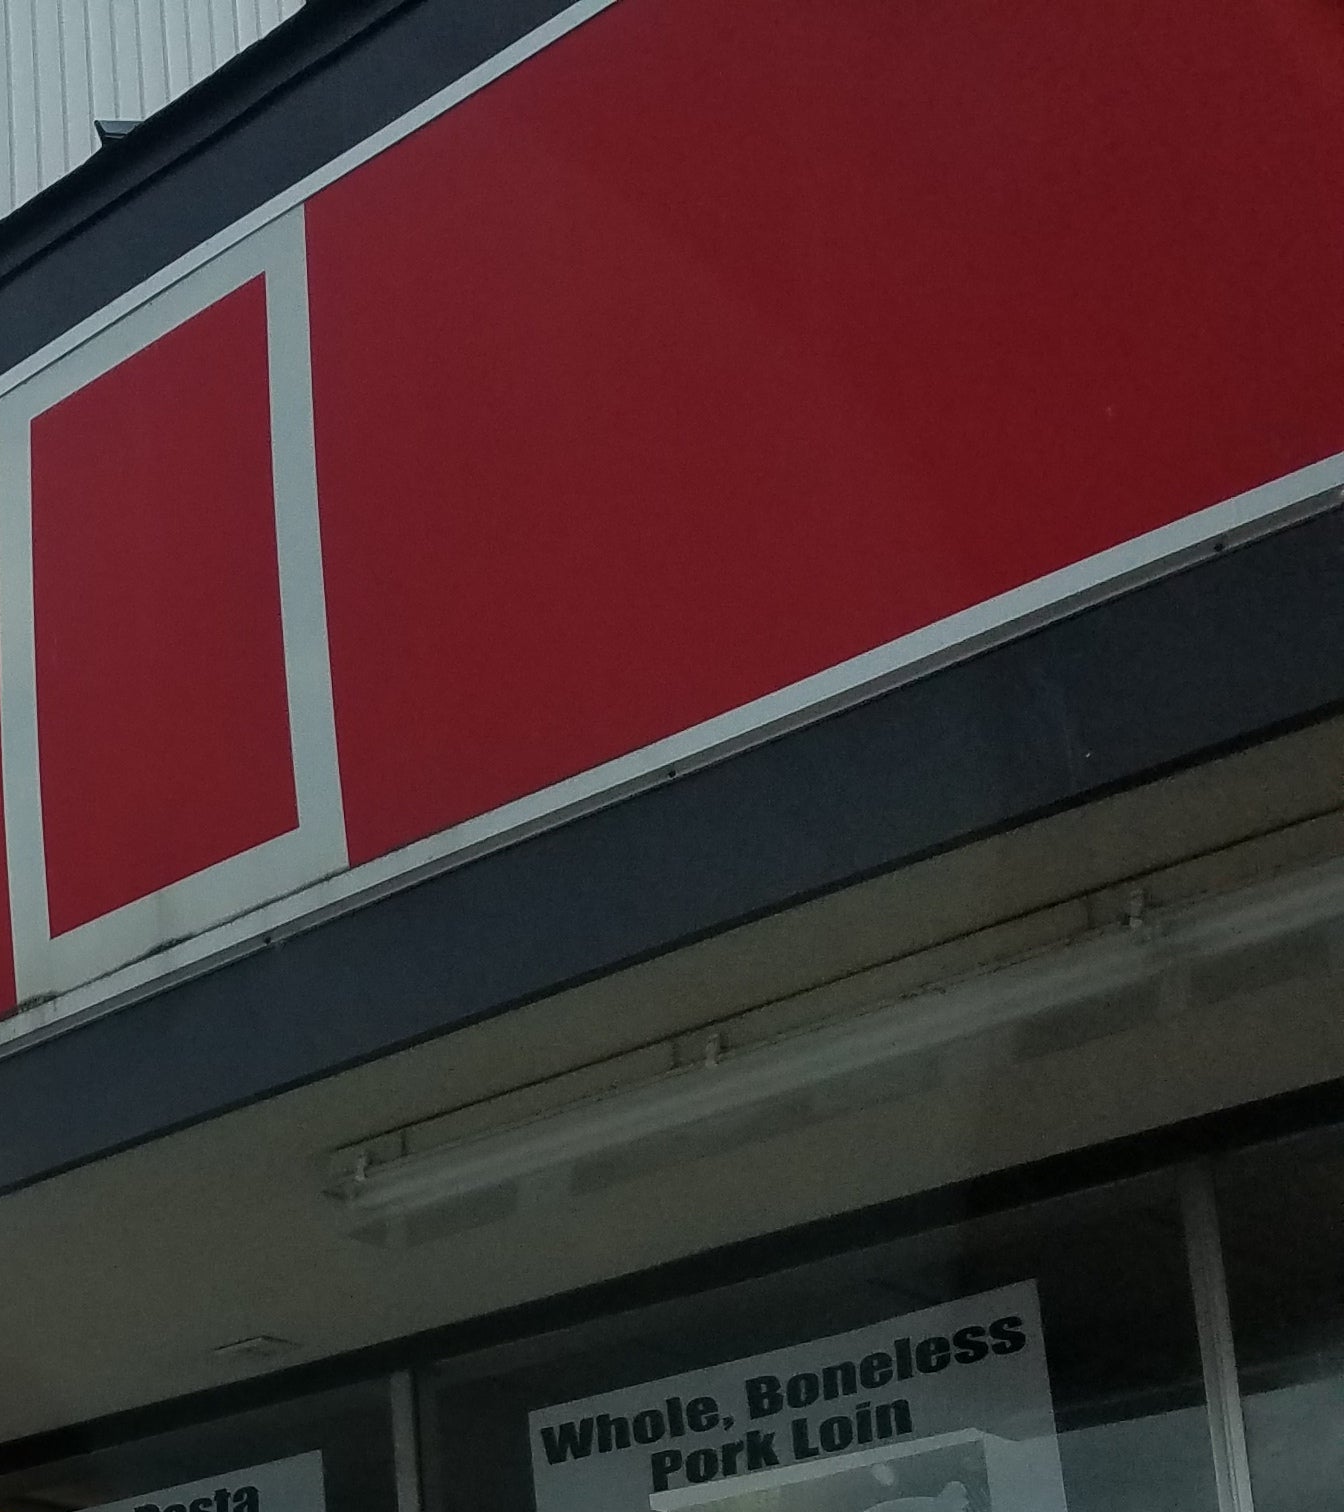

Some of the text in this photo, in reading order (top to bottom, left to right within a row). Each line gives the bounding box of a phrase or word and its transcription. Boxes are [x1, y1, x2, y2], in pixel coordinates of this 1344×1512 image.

[541, 1315, 1027, 1465] Whole, Boneless
[650, 1399, 912, 1492] Pork Loin
